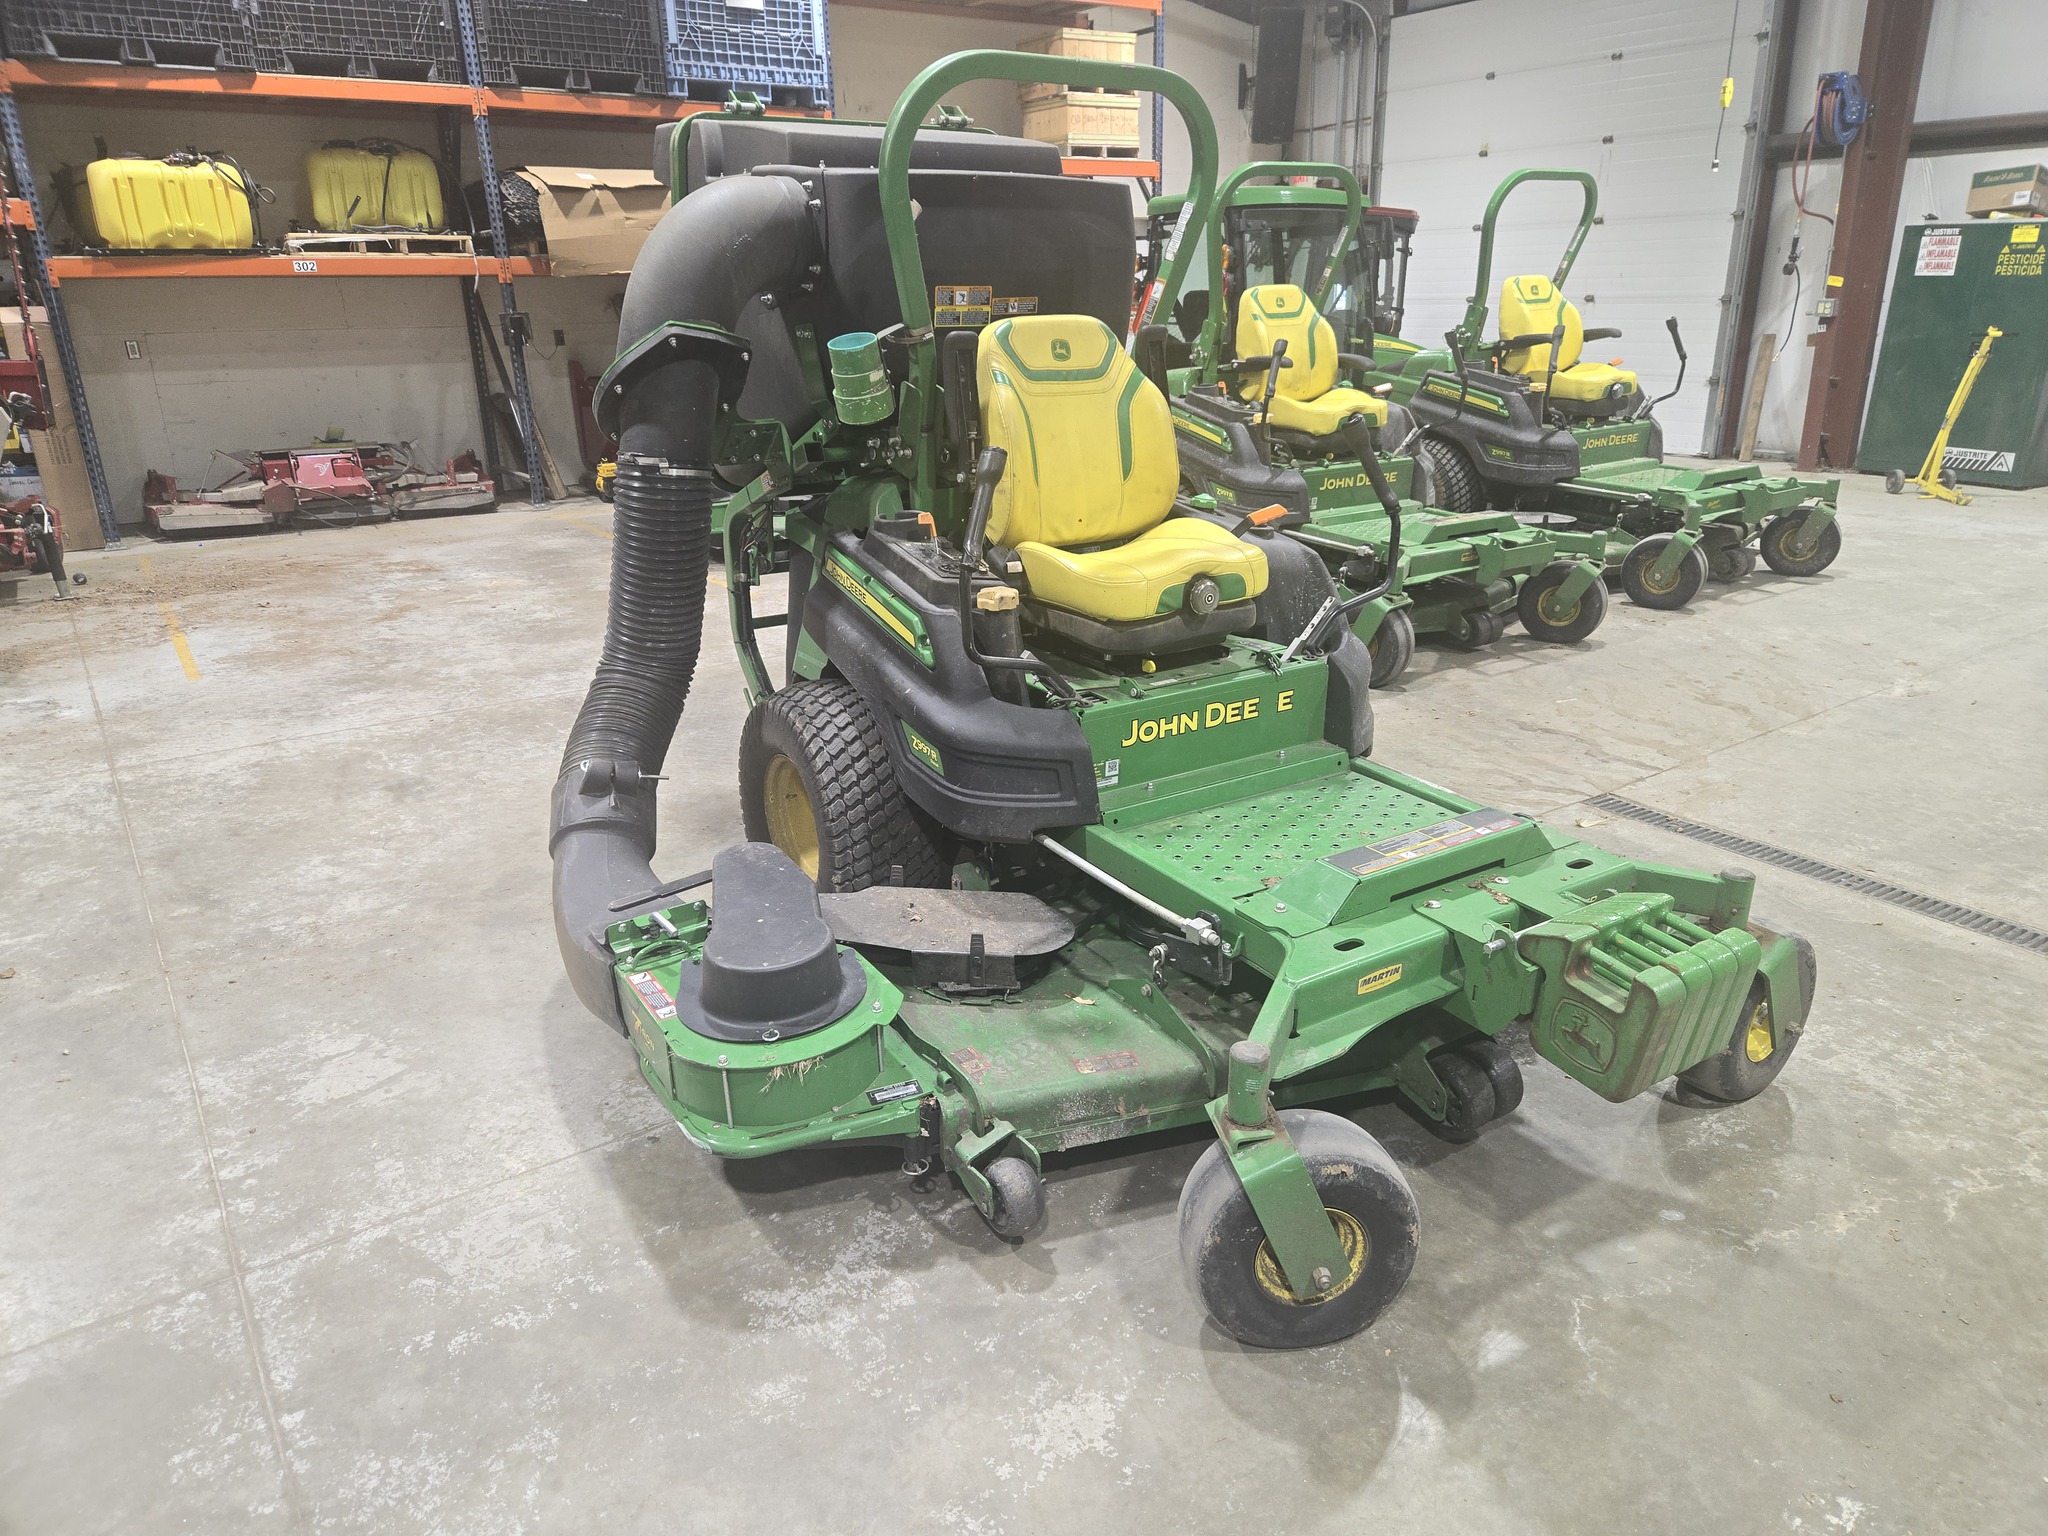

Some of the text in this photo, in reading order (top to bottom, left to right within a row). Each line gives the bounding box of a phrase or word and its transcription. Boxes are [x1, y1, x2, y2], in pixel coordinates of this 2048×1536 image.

[1929, 236, 1960, 247] FLAMMABLE
[1926, 249, 1957, 258] INFLAMABLE
[1997, 253, 2046, 265] PESTICIDE
[294, 261, 316, 271] 302
[1995, 264, 2043, 275] PESTICIDA
[1582, 433, 1639, 450] JOHN DEERE
[1953, 450, 1989, 460] JUSTRITE
[1319, 476, 1354, 491] JOHN
[829, 562, 867, 605] JOHN DEERE
[1121, 710, 1199, 748] JOHN
[1361, 966, 1401, 987] MARTIN
